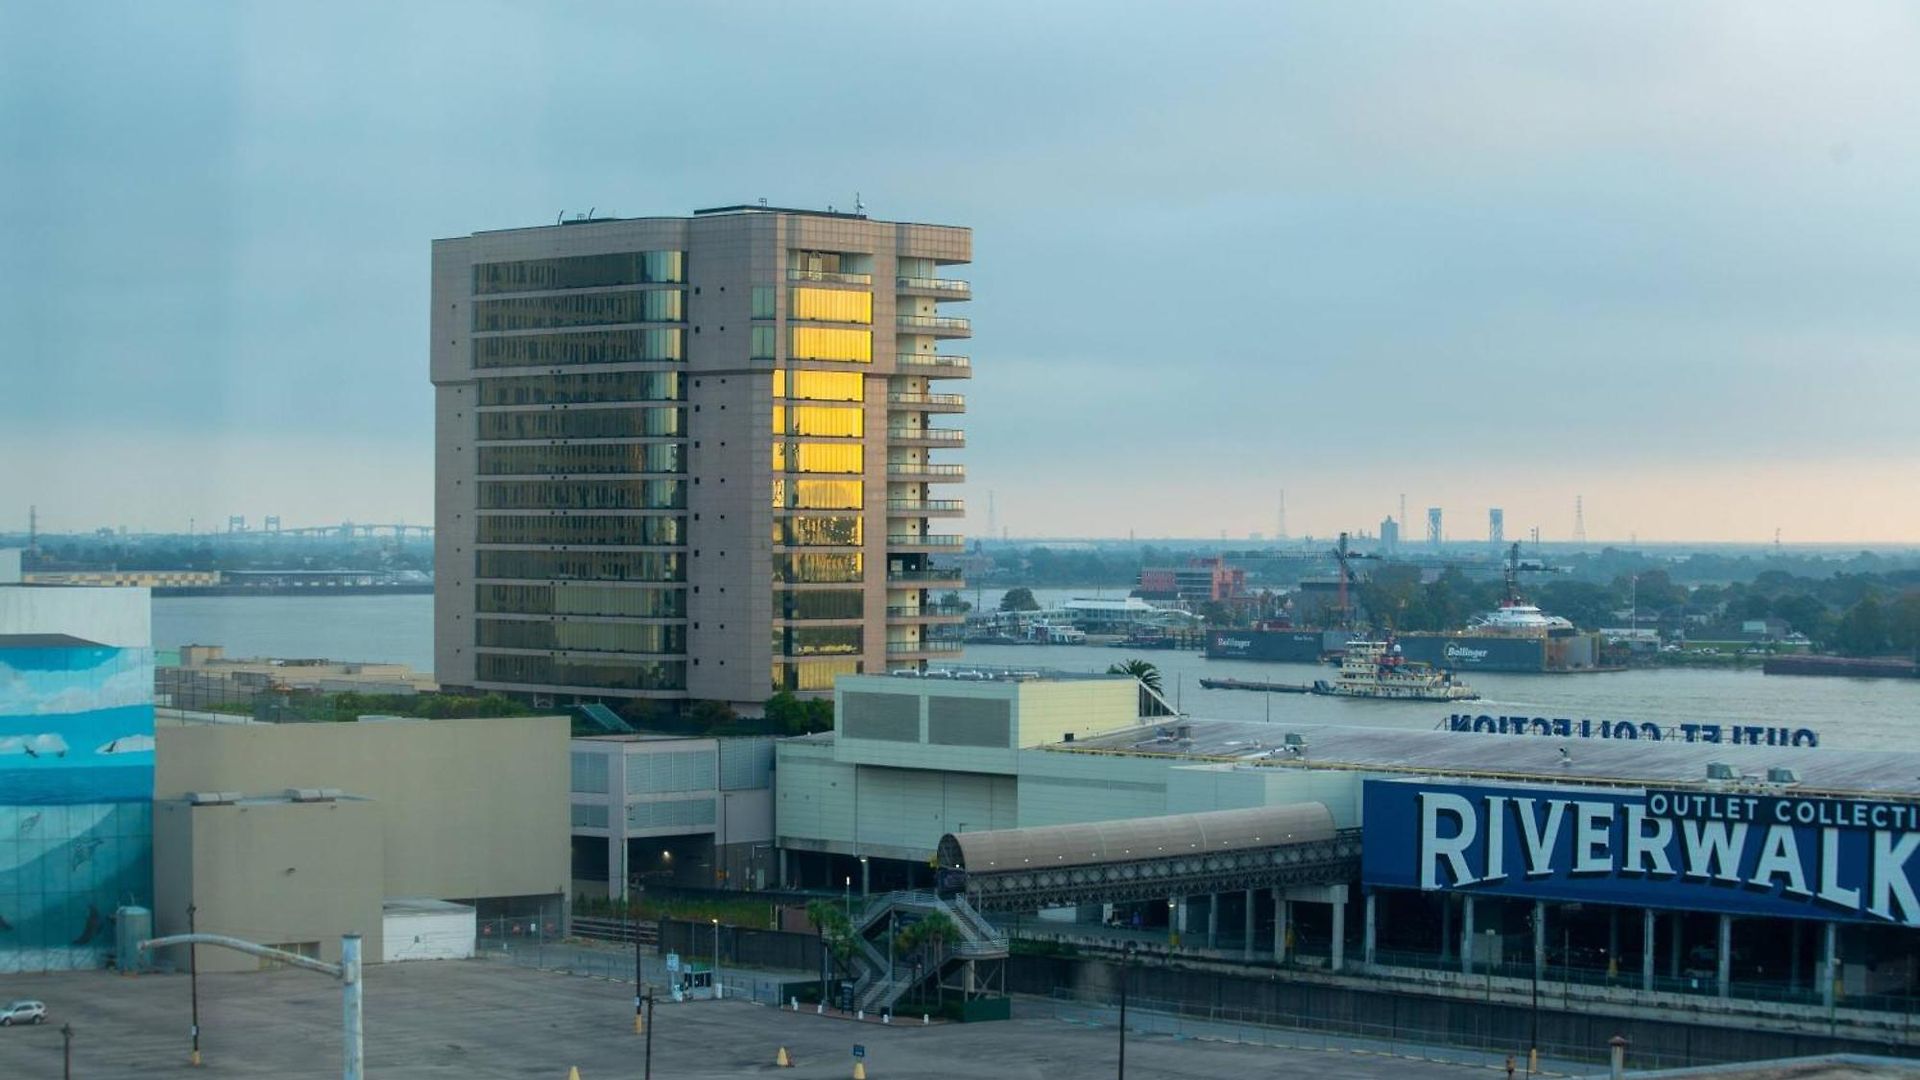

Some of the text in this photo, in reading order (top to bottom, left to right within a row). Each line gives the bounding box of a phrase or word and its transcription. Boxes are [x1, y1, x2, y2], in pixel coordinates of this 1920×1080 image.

[1447, 647, 1488, 659] Bollinger
[1650, 794, 1917, 829] OUTLET COLLECTI
[1418, 791, 1920, 928] RIVERWALK
